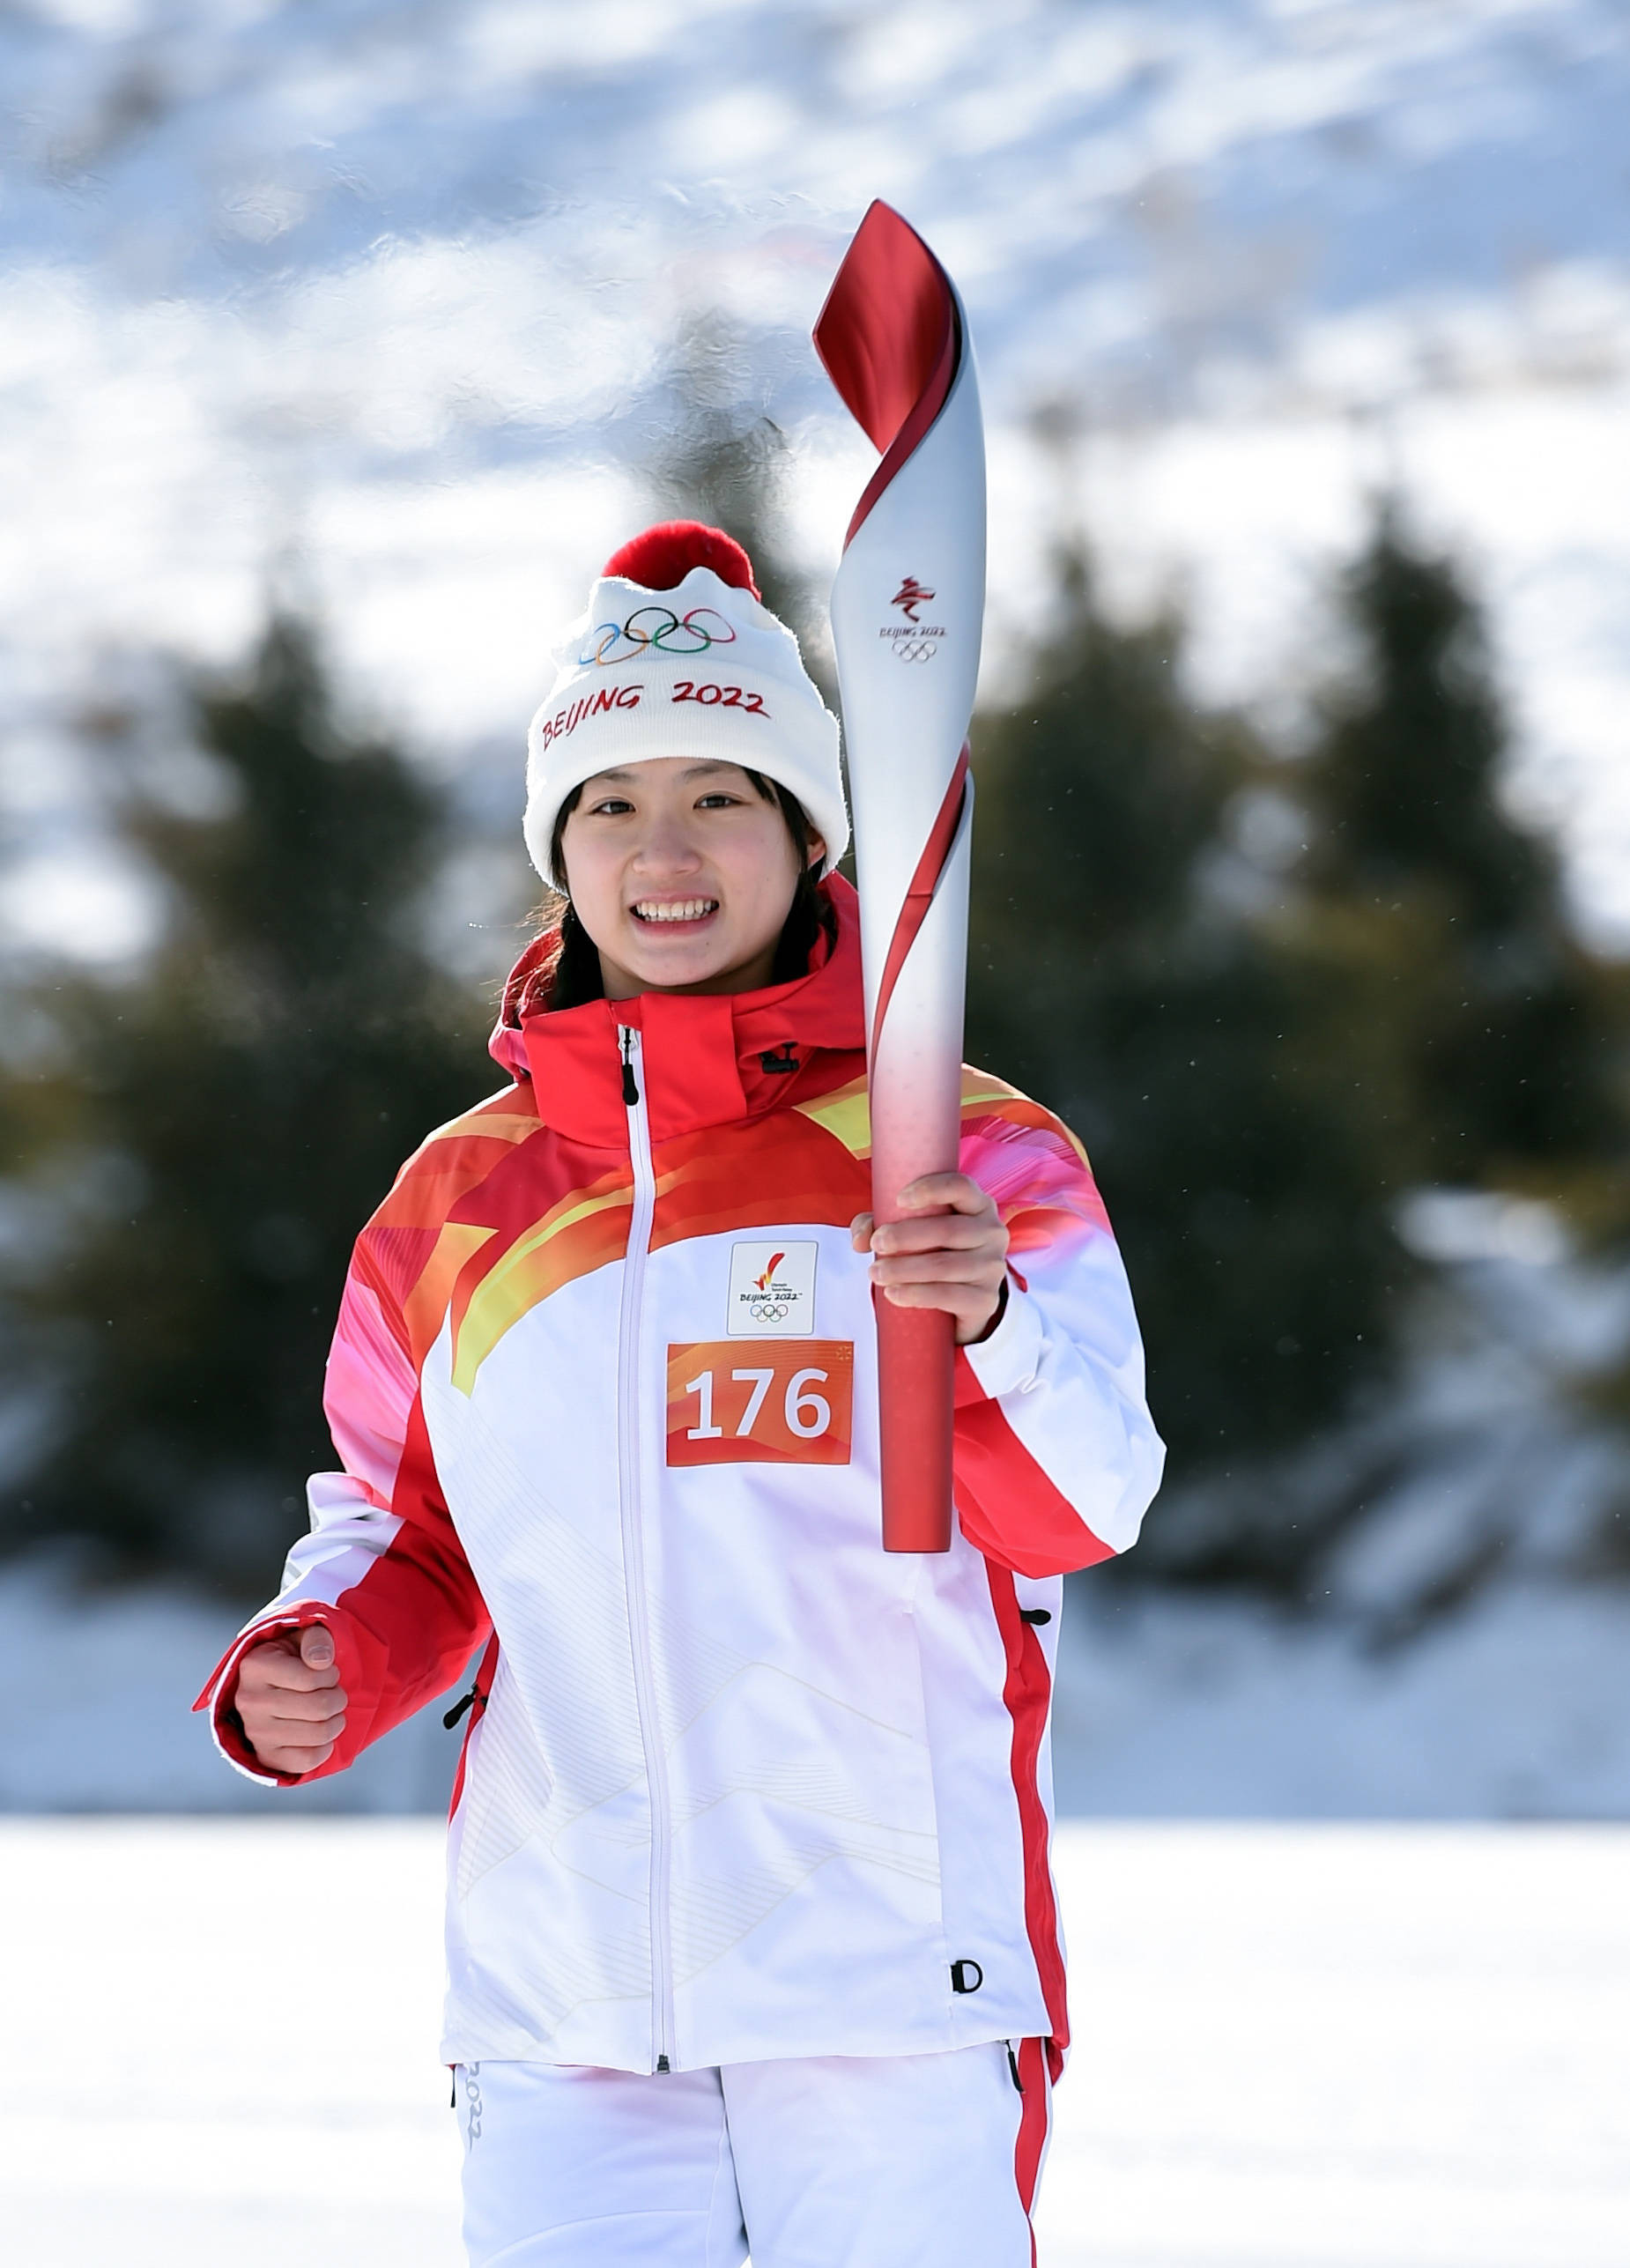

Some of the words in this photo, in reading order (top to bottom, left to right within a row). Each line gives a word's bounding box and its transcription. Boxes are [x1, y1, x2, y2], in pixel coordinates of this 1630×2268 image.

[542, 685, 644, 751] BEIJING
[671, 681, 772, 719] 2022
[739, 1293, 772, 1303] BEIJING
[685, 1367, 831, 1439] 176
